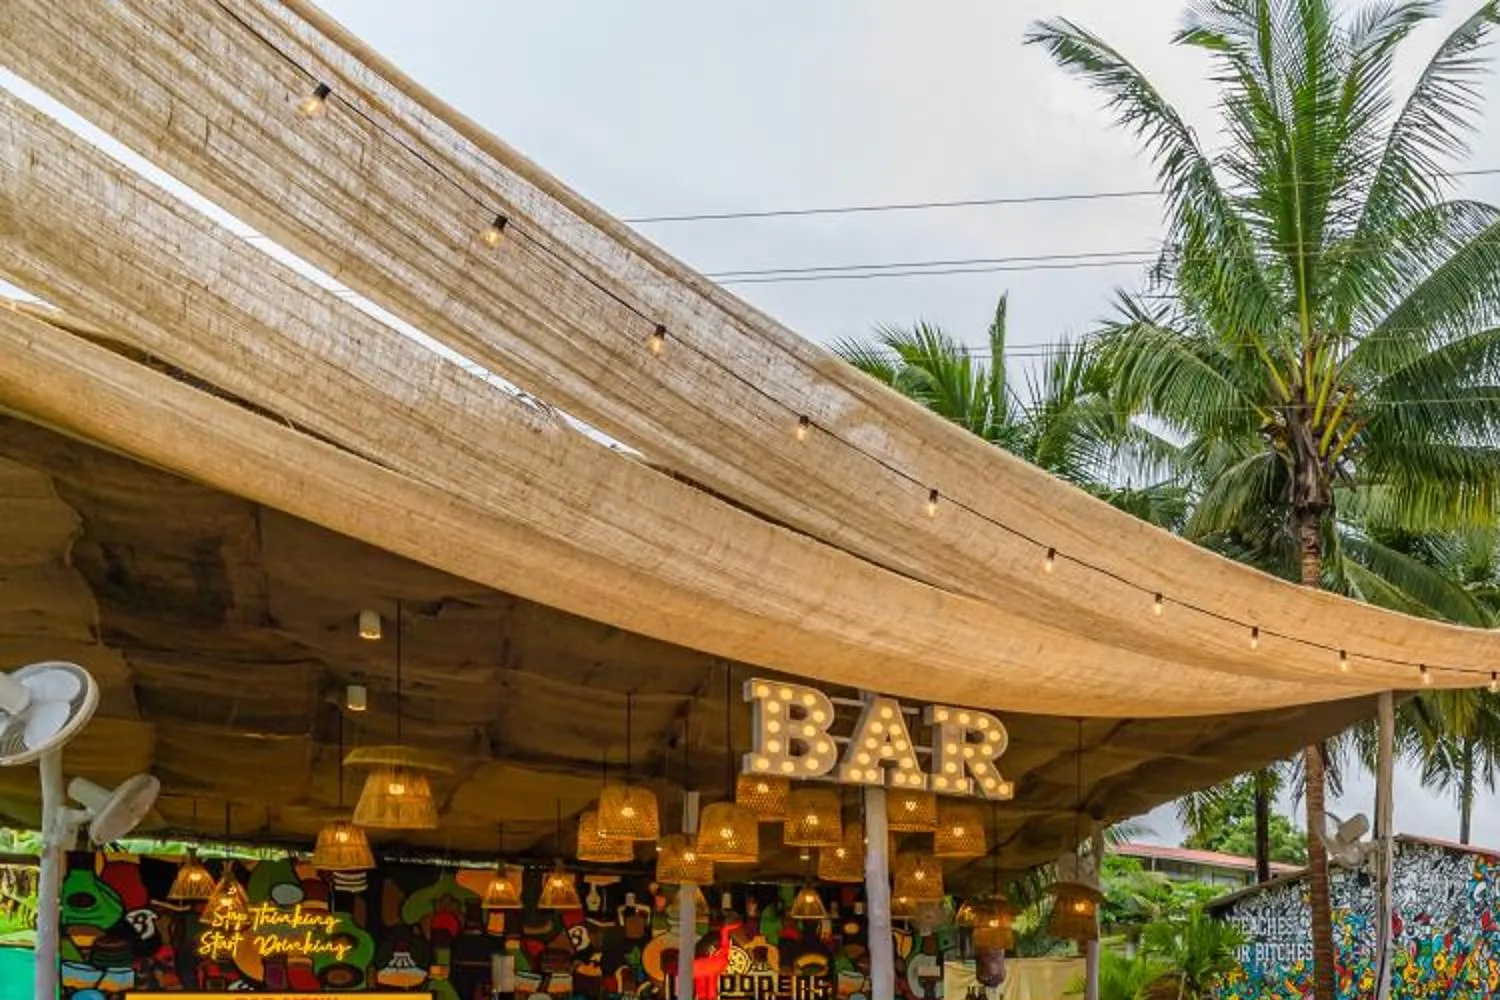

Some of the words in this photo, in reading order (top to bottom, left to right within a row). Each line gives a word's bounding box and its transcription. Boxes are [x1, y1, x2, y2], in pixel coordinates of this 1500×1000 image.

[744, 678, 1013, 800] BAR
[212, 904, 248, 931] Stop
[248, 902, 343, 934] Thinking
[199, 930, 245, 960] Start
[253, 930, 352, 960] Drinking
[1256, 942, 1313, 962] BITCHES
